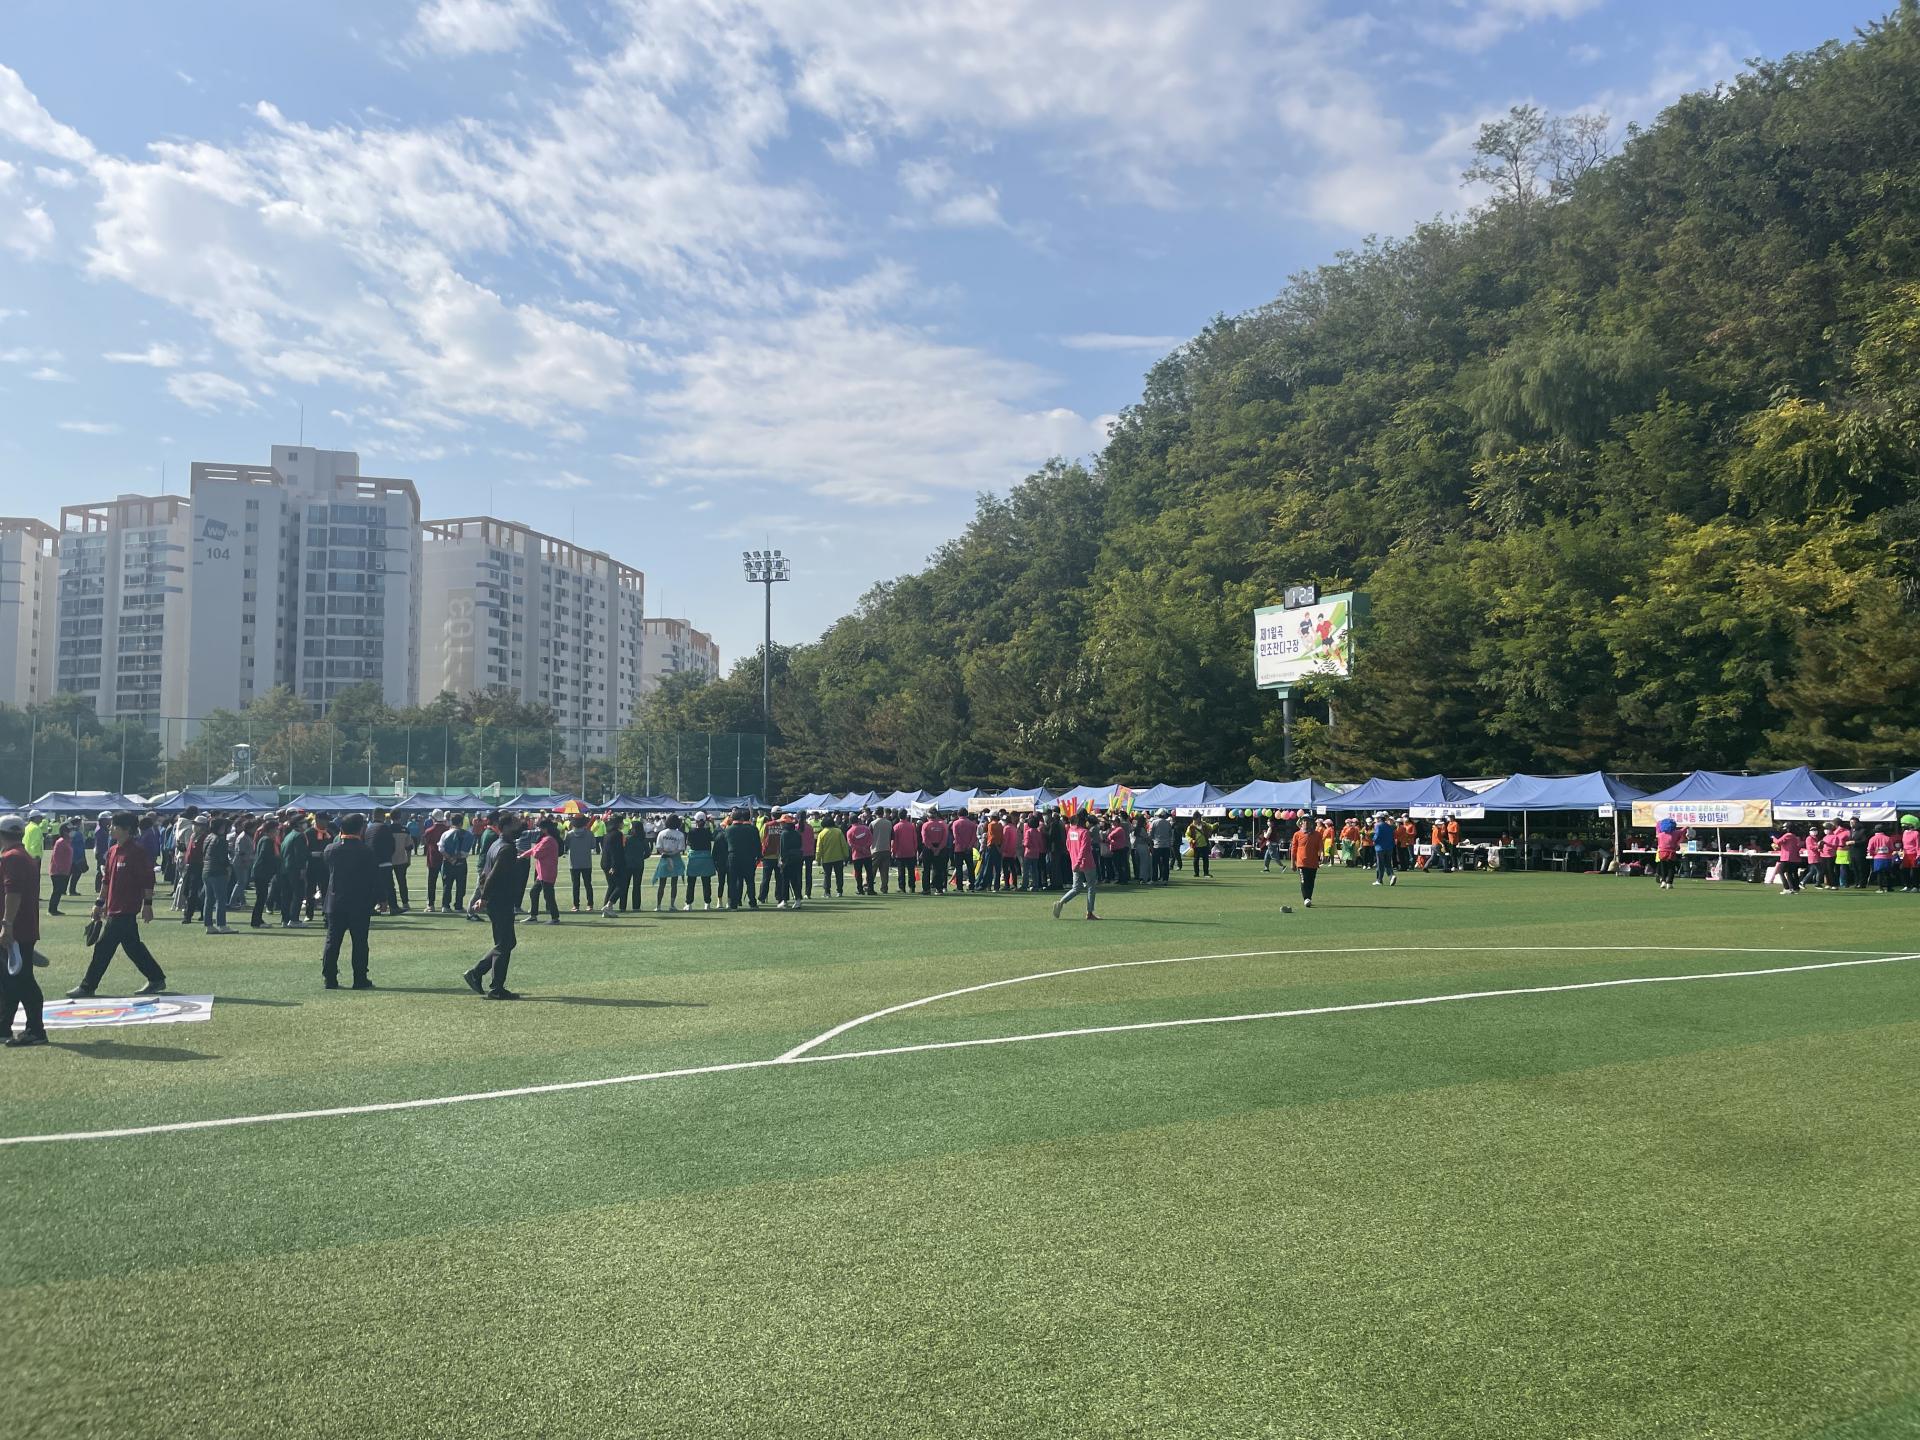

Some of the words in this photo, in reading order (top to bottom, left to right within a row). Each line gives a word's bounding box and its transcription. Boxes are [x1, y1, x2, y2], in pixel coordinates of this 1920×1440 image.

[207, 547, 231, 560] 104
[1260, 626, 1283, 640] 제1월곡
[1260, 639, 1299, 657] 인조잔디구장
[1698, 812, 1729, 823] 화이팅!!
